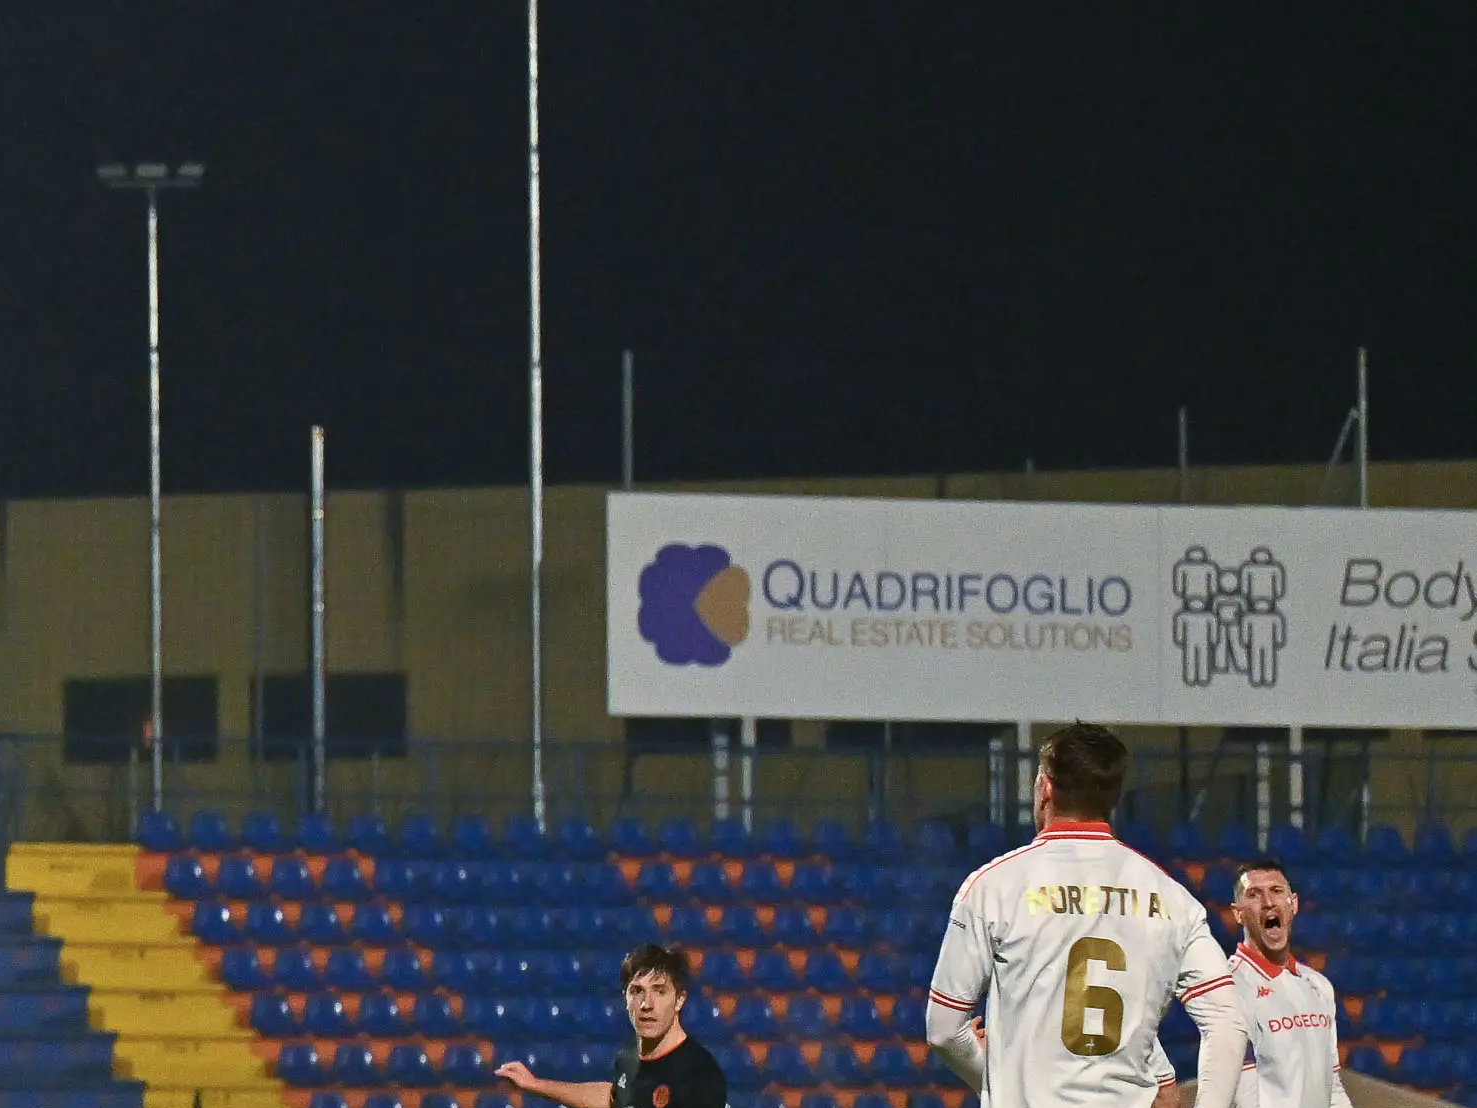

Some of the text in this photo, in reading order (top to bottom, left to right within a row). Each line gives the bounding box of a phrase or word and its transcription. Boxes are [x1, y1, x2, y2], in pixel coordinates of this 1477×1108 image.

[762, 558, 1132, 616] QUADRIFOGLIO
[766, 615, 1135, 652] REAL ESTATE SOLUTIONS
[1324, 623, 1449, 673] Italia
[1026, 885, 1140, 917] MORETTI
[1061, 936, 1128, 1057] 6
